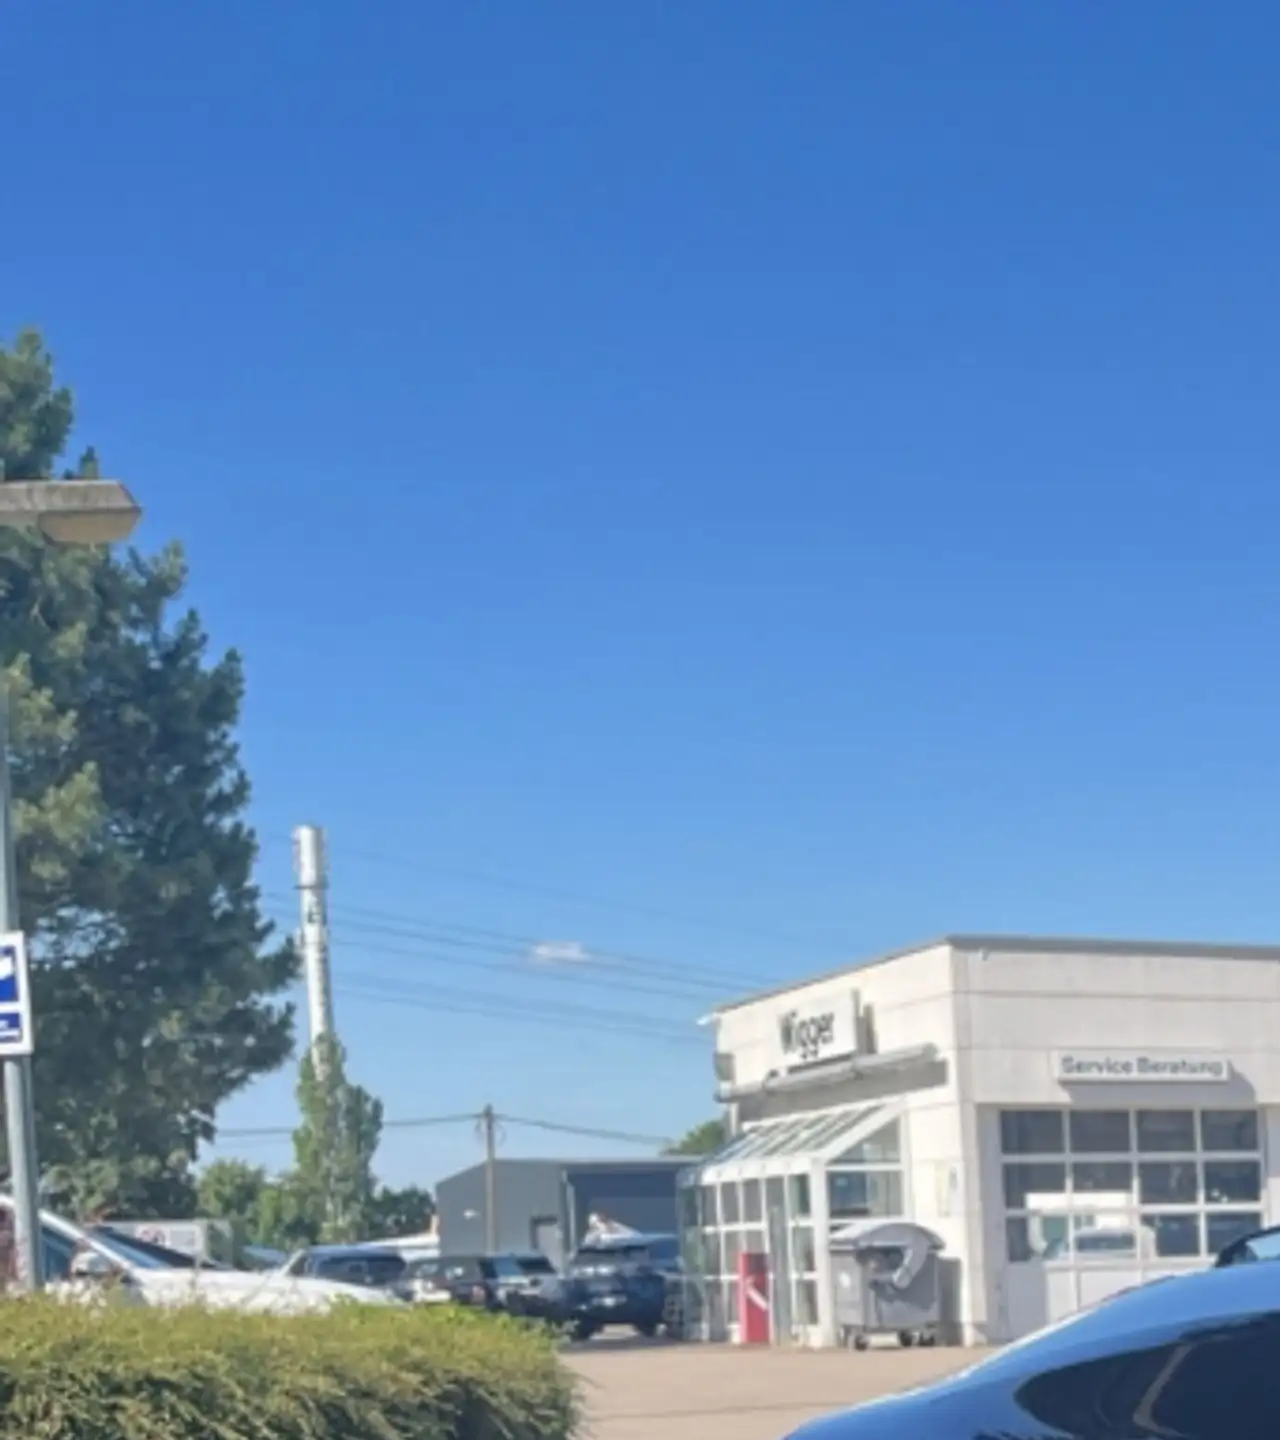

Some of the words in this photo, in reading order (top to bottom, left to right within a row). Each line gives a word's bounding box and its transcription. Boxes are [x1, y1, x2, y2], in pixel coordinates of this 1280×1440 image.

[777, 1009, 834, 1060] Wigger
[1061, 1055, 1134, 1075] Service
[1136, 1055, 1224, 1076] Beratung
